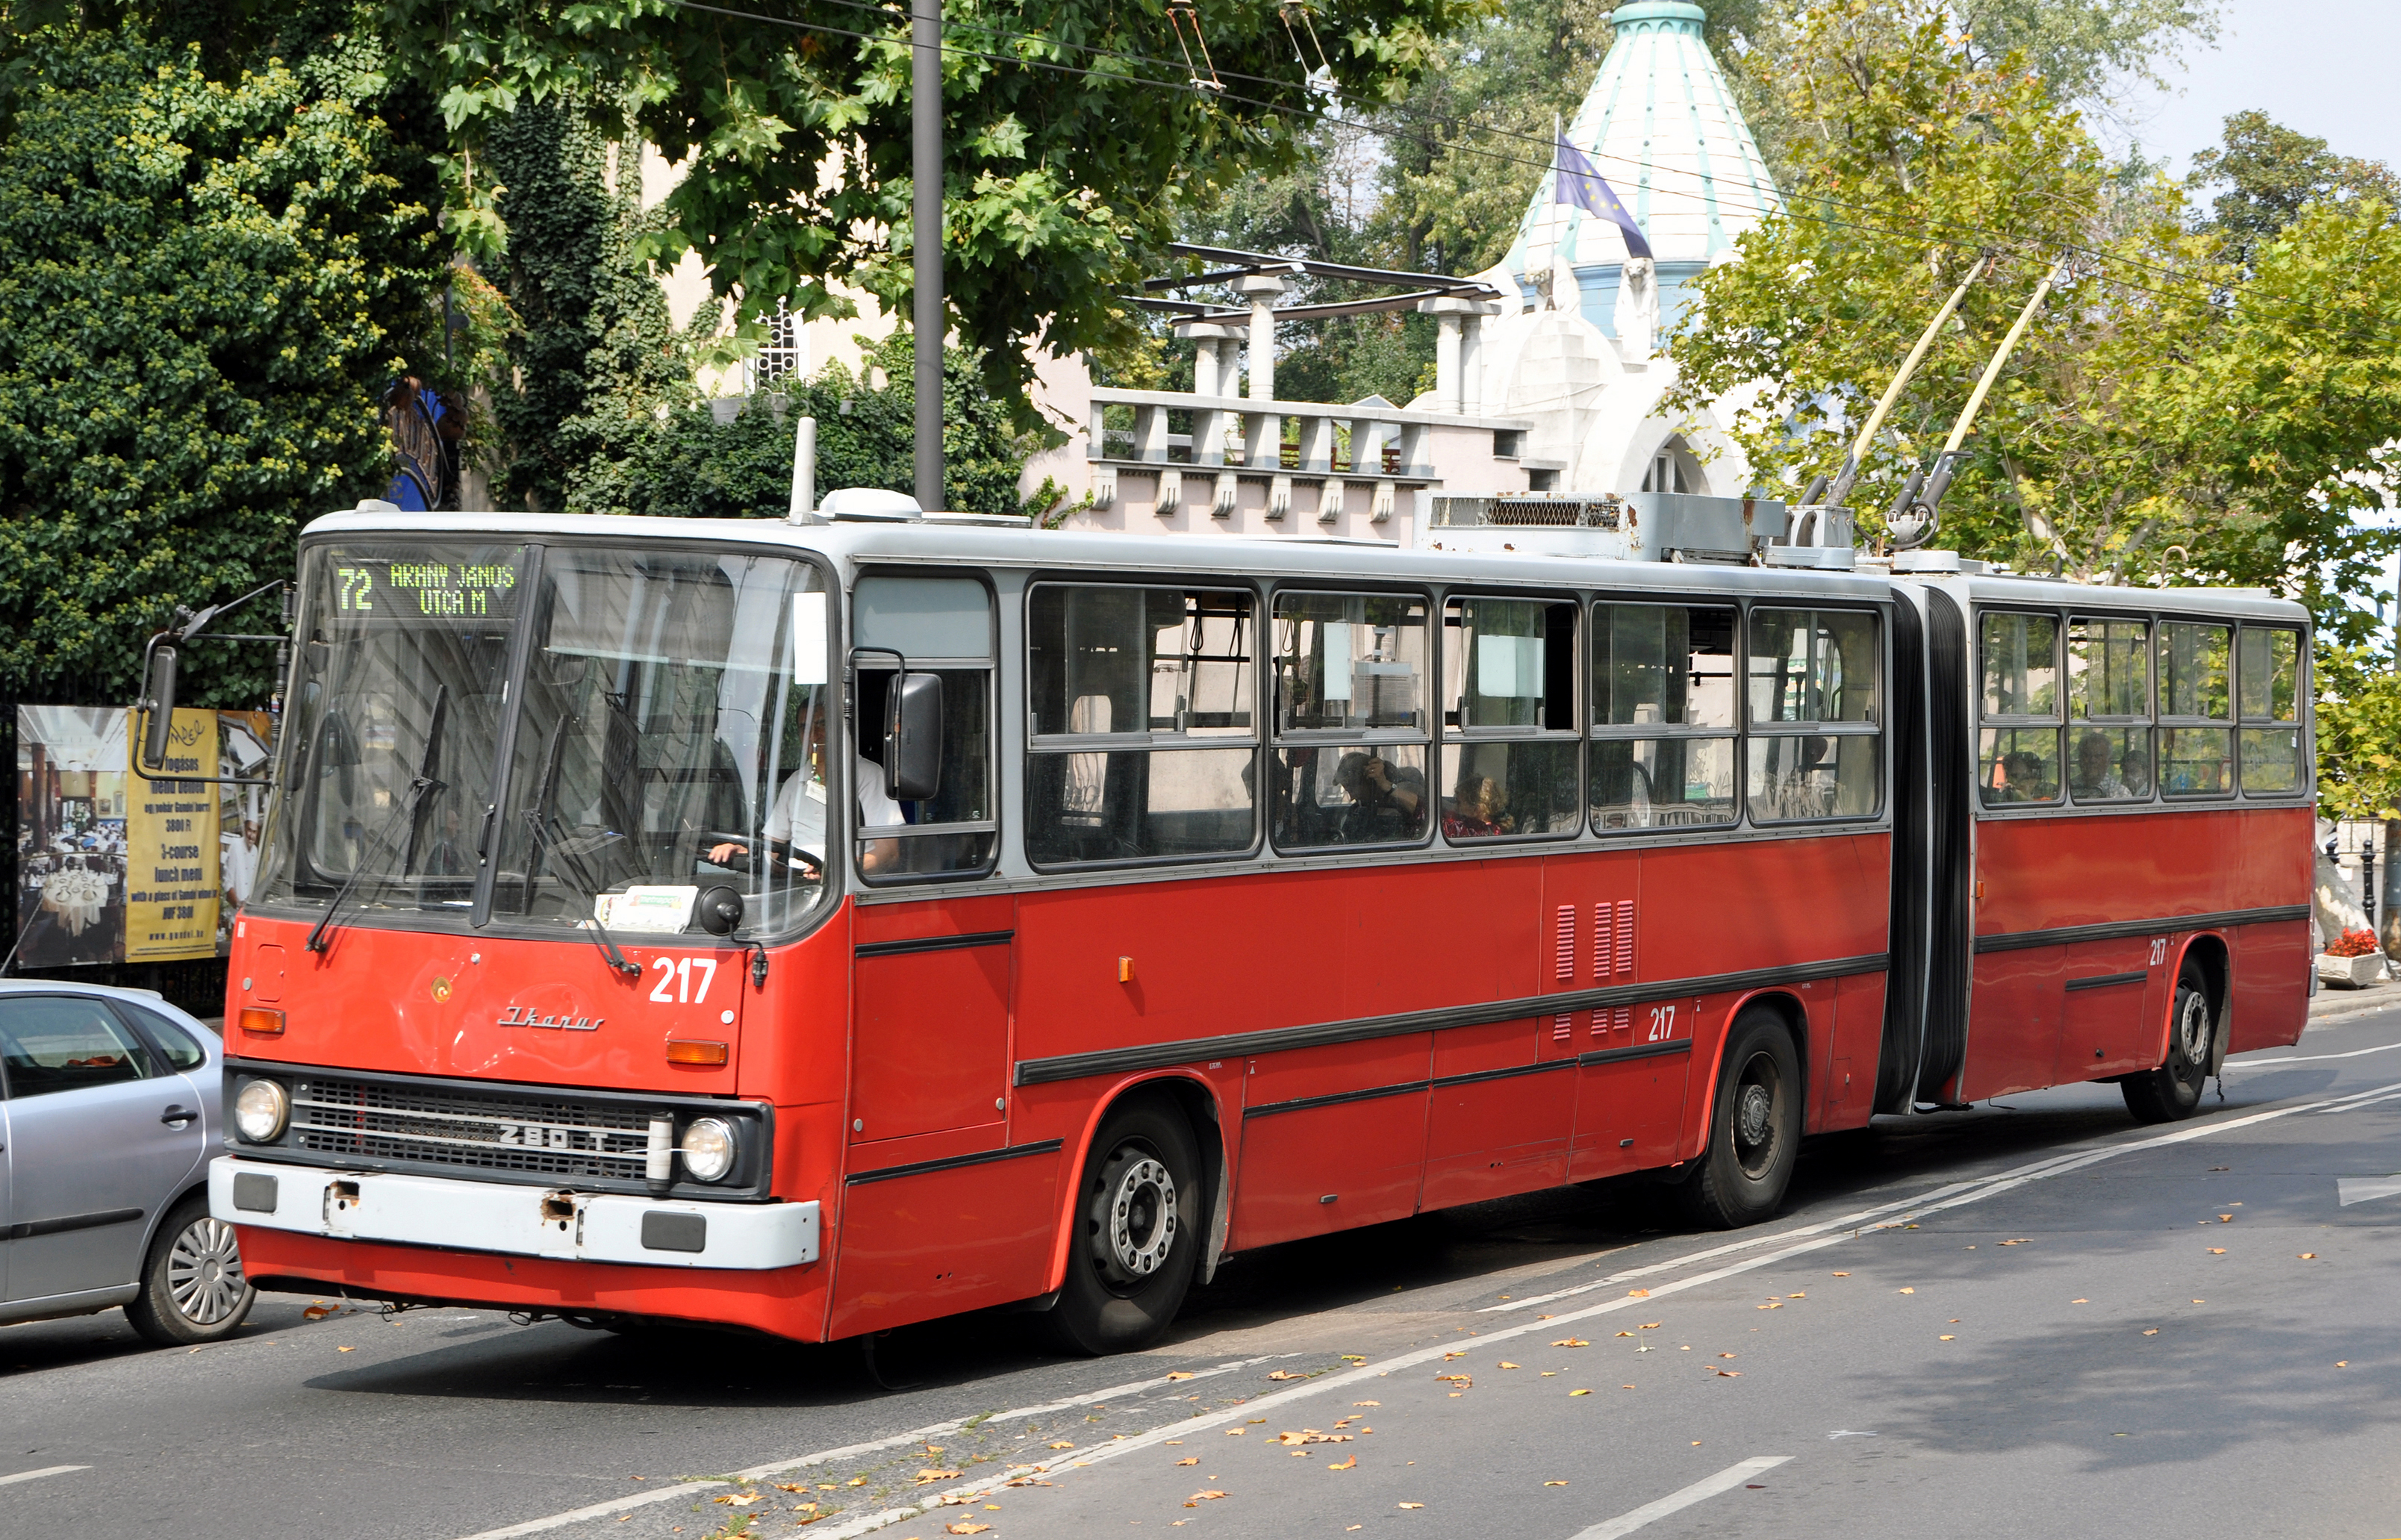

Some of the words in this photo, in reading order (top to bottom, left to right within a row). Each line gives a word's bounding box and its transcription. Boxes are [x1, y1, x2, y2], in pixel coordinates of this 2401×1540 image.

[337, 567, 373, 611] 72
[390, 564, 449, 588] ARANY
[420, 589, 464, 614] UTCA
[470, 589, 486, 614] M
[161, 844, 199, 859] 3-course
[155, 866, 178, 882] lunch
[2149, 938, 2166, 966] 217
[648, 957, 717, 1005] 217
[496, 1006, 605, 1031] Ikarus
[1648, 1005, 1675, 1041] 217
[499, 1125, 569, 1149] 280
[589, 1132, 609, 1152] T
